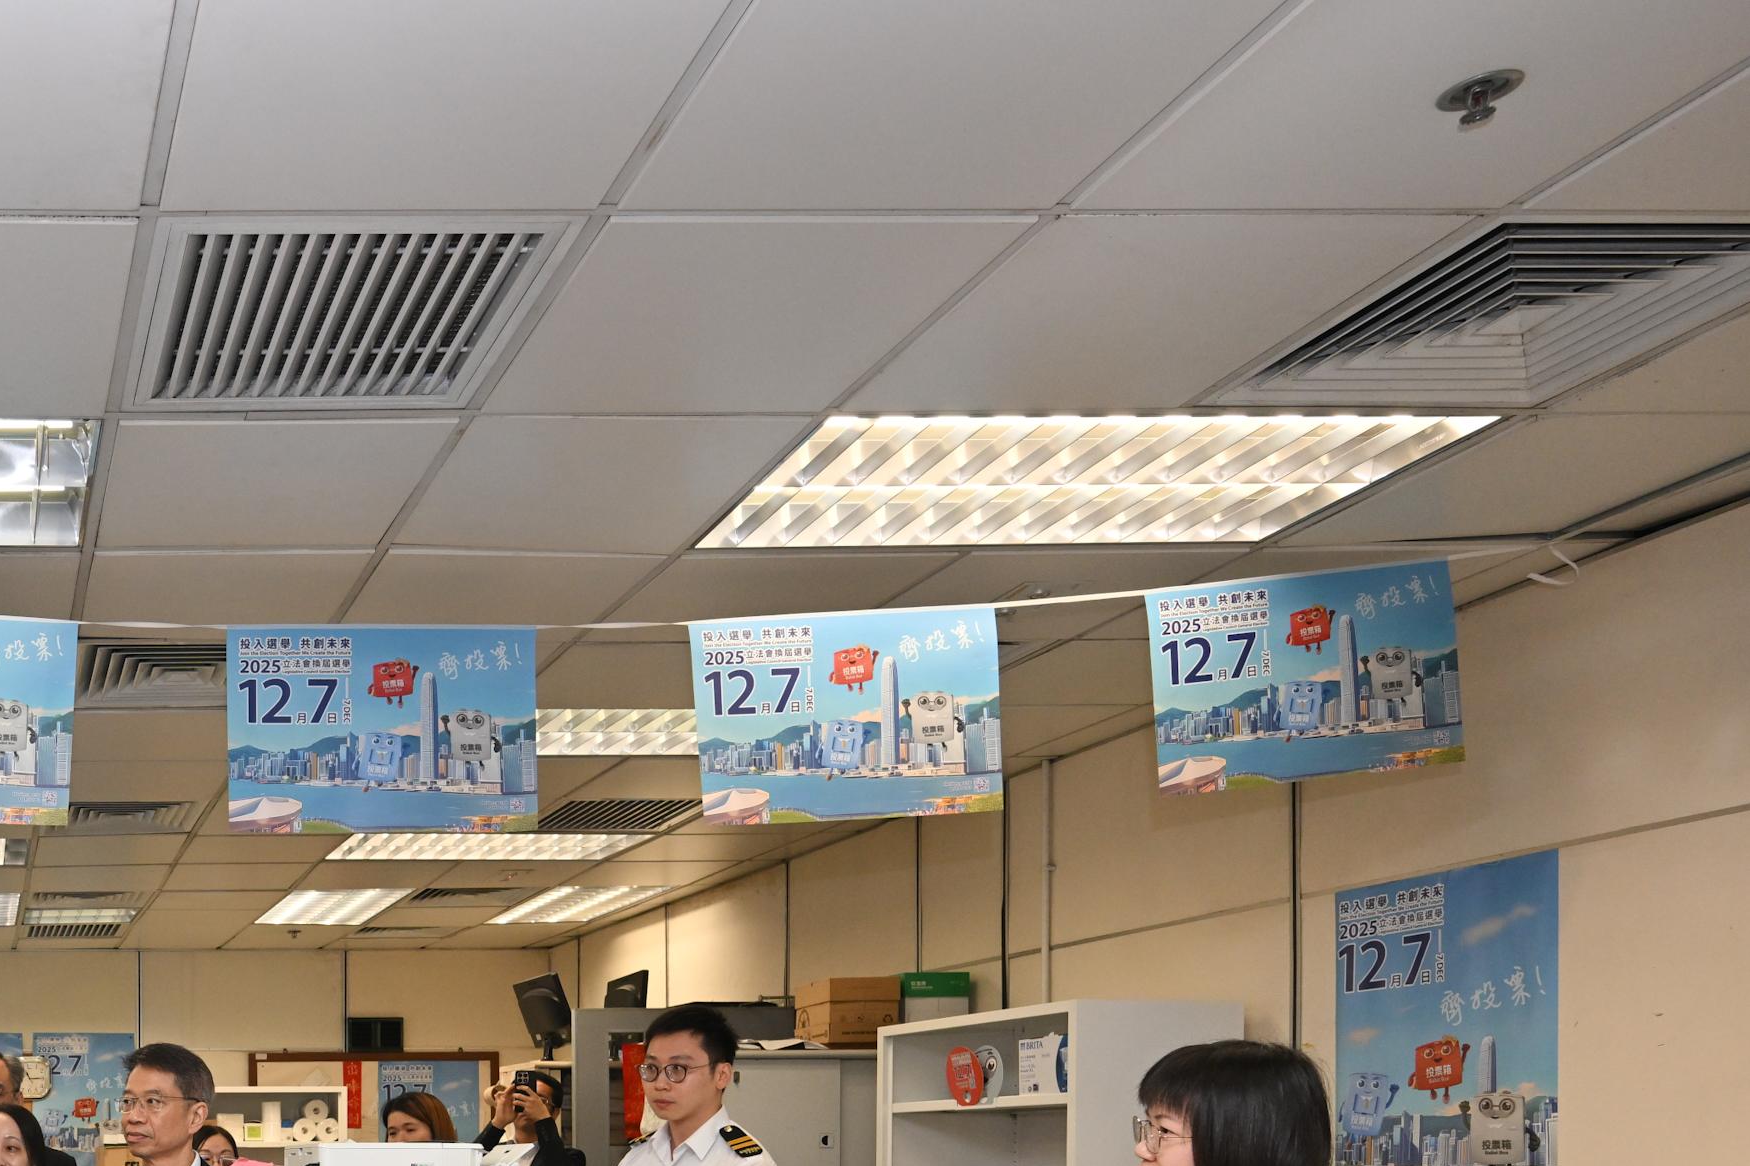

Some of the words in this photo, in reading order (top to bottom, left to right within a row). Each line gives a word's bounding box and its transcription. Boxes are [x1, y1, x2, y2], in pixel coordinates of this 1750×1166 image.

[1160, 597, 1209, 612] 投入選舉
[1219, 590, 1267, 605] 共創未來
[703, 630, 752, 641] 投入選舉
[762, 627, 811, 638] 共創未來
[240, 639, 290, 649] 投入選舉
[301, 639, 350, 649] 共創未來
[1340, 895, 1387, 914] 投入選舉
[1397, 884, 1443, 904] 共創未來
[1026, 1041, 1043, 1050] BRITA
[1426, 1065, 1452, 1078] 投票箱
[1482, 1139, 1511, 1150] 投票箱
